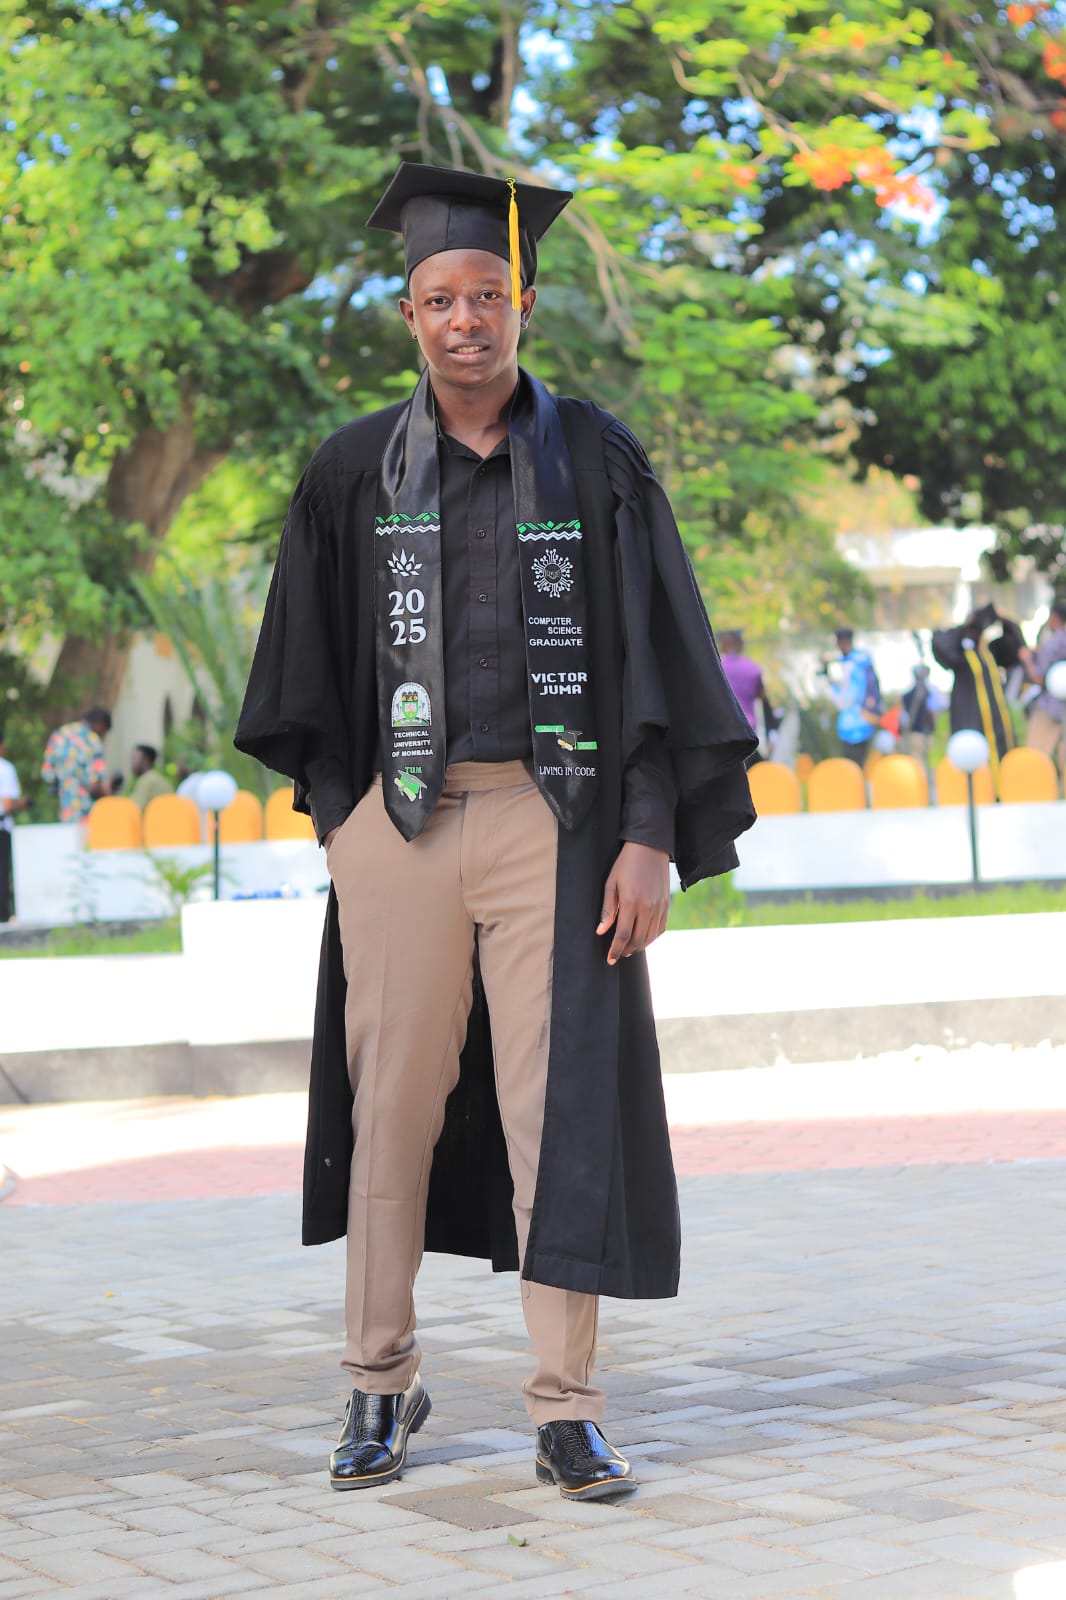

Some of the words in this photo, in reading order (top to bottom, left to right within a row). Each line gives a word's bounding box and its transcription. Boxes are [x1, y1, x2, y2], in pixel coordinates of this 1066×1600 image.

[388, 588, 425, 616] 20
[528, 616, 572, 625] COMPUTER
[390, 617, 427, 646] 25
[547, 626, 583, 635] SCIENCE
[529, 638, 584, 647] GRADUATE
[531, 672, 587, 684] VICTOR
[539, 684, 582, 696] JUMA
[393, 730, 429, 738] TECHNICAL
[393, 740, 431, 748] UNIVERSITY
[401, 749, 434, 757] MOMBASA
[539, 766, 563, 776] LIVING
[564, 766, 573, 776] IN
[574, 767, 596, 777] CODE
